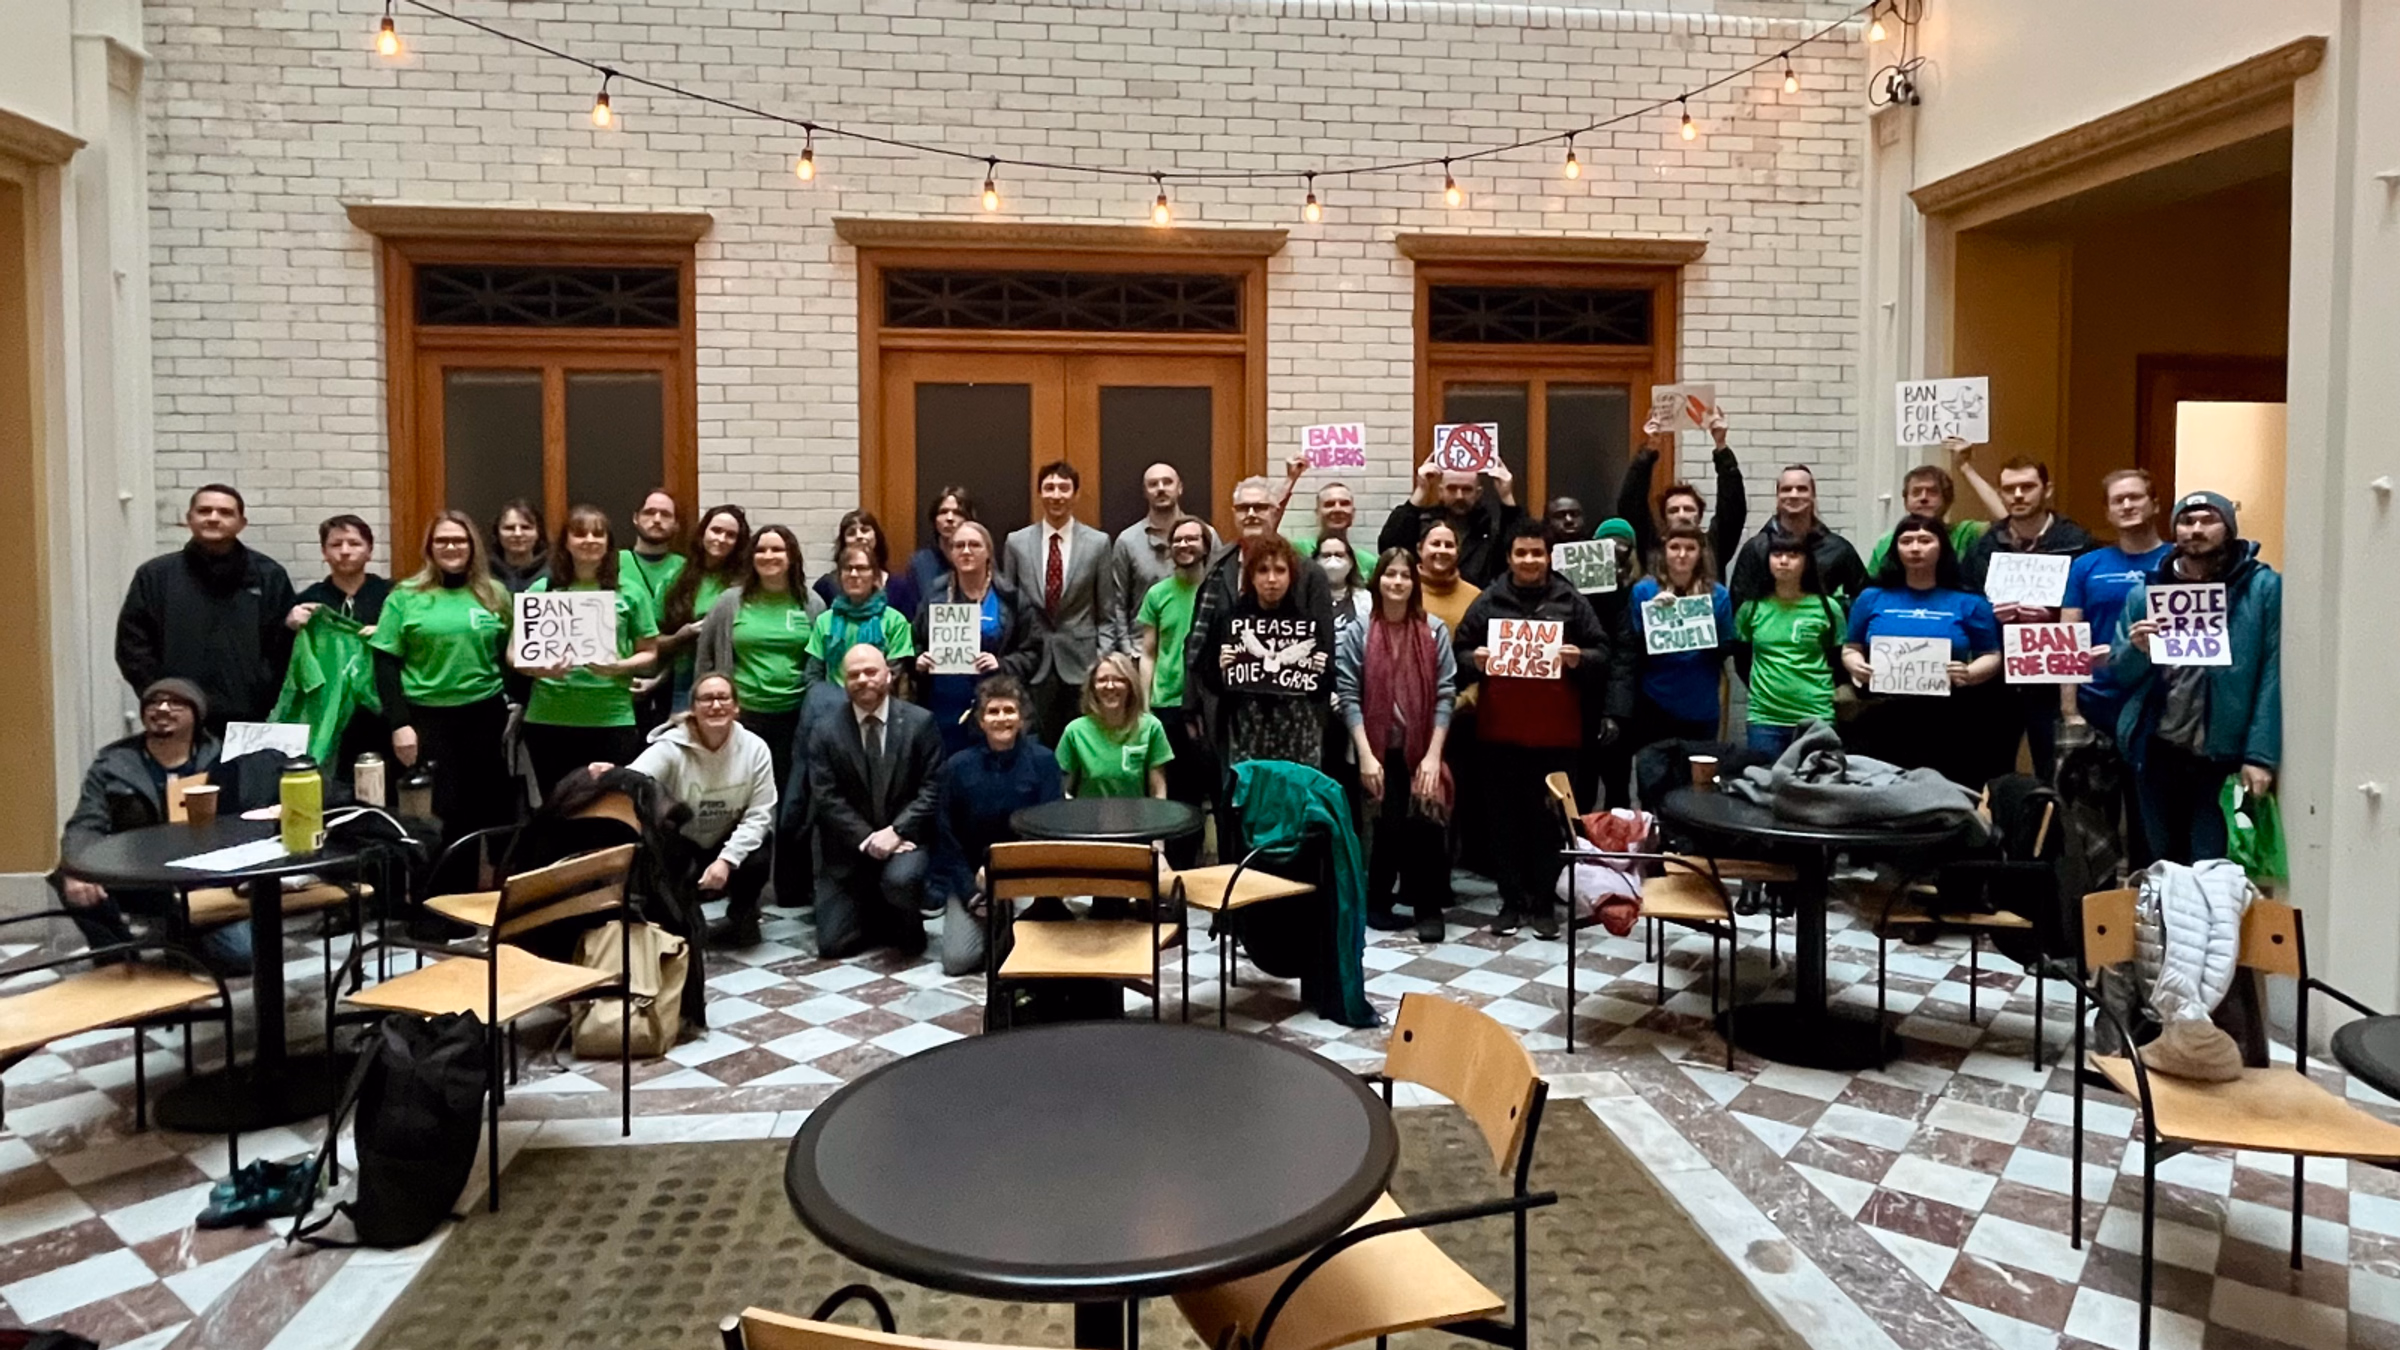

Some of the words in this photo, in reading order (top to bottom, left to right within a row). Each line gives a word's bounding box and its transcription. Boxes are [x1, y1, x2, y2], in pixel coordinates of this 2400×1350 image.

[1904, 385, 1936, 403] BAN
[1904, 404, 1941, 423] FOIE
[1308, 426, 1358, 446] BAN
[1563, 543, 1605, 565] BAN
[523, 597, 573, 619] BAN
[2150, 589, 2225, 615] FOIE
[934, 606, 971, 624] BAN
[524, 618, 583, 640] FOIE
[932, 626, 973, 643] FOIE
[1231, 618, 1317, 637] PLEASE!
[1499, 620, 1558, 644] BAN
[1649, 624, 1717, 651] CRUEL!
[2020, 625, 2078, 653] BAN
[2165, 638, 2221, 658] BAD
[521, 640, 596, 661] GRAS
[932, 646, 977, 666] GRAS
[1486, 656, 1561, 677] GRAS!
[1890, 661, 1947, 678] HATE
[2046, 651, 2092, 676] GRAS
[1279, 668, 1319, 691] GRAS
[1872, 673, 1915, 691] FOIE
[1916, 676, 1949, 691] GRA
[227, 724, 273, 743] STOP
